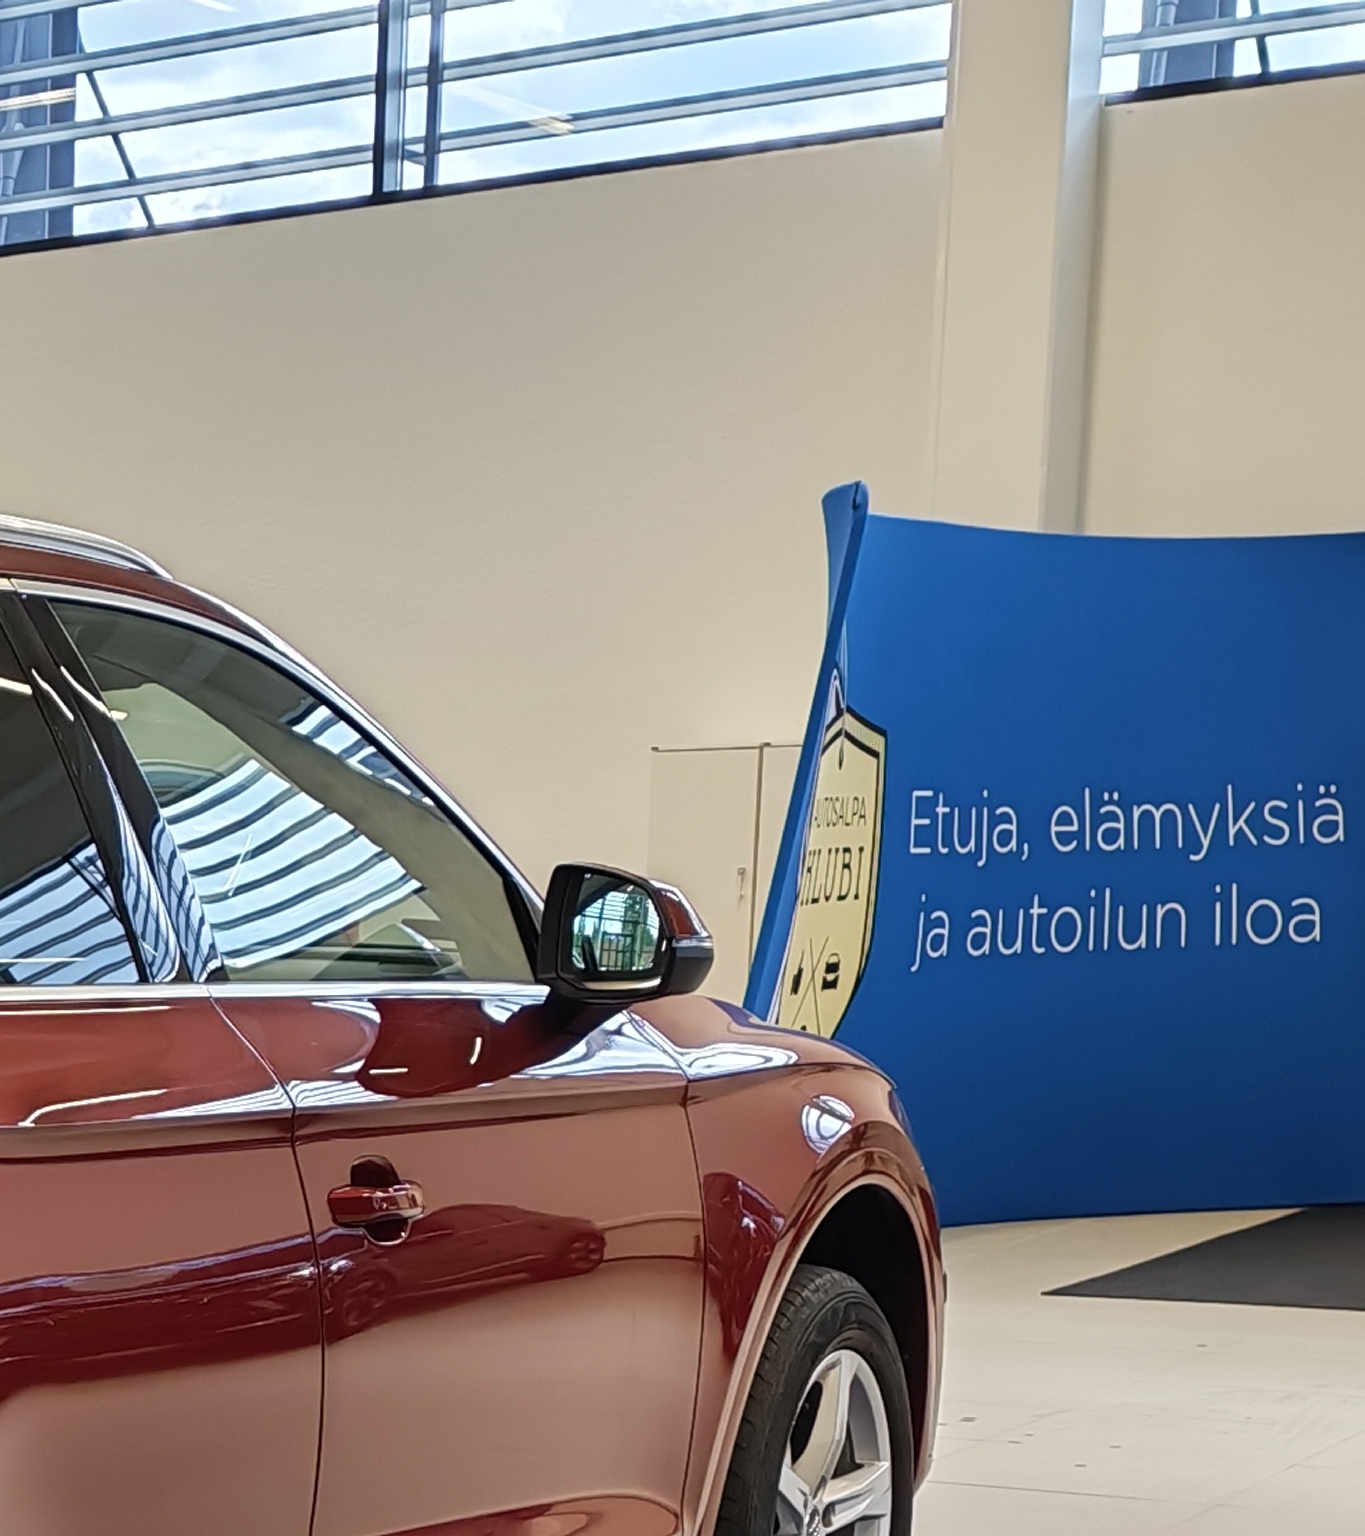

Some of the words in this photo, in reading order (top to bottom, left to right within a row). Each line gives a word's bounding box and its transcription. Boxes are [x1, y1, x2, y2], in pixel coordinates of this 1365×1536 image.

[909, 789, 1030, 867] Etuja,
[1050, 783, 1345, 862] elämyksiä
[910, 893, 950, 972] ja
[967, 887, 1187, 957] autoilun
[1214, 882, 1322, 947] iloa
